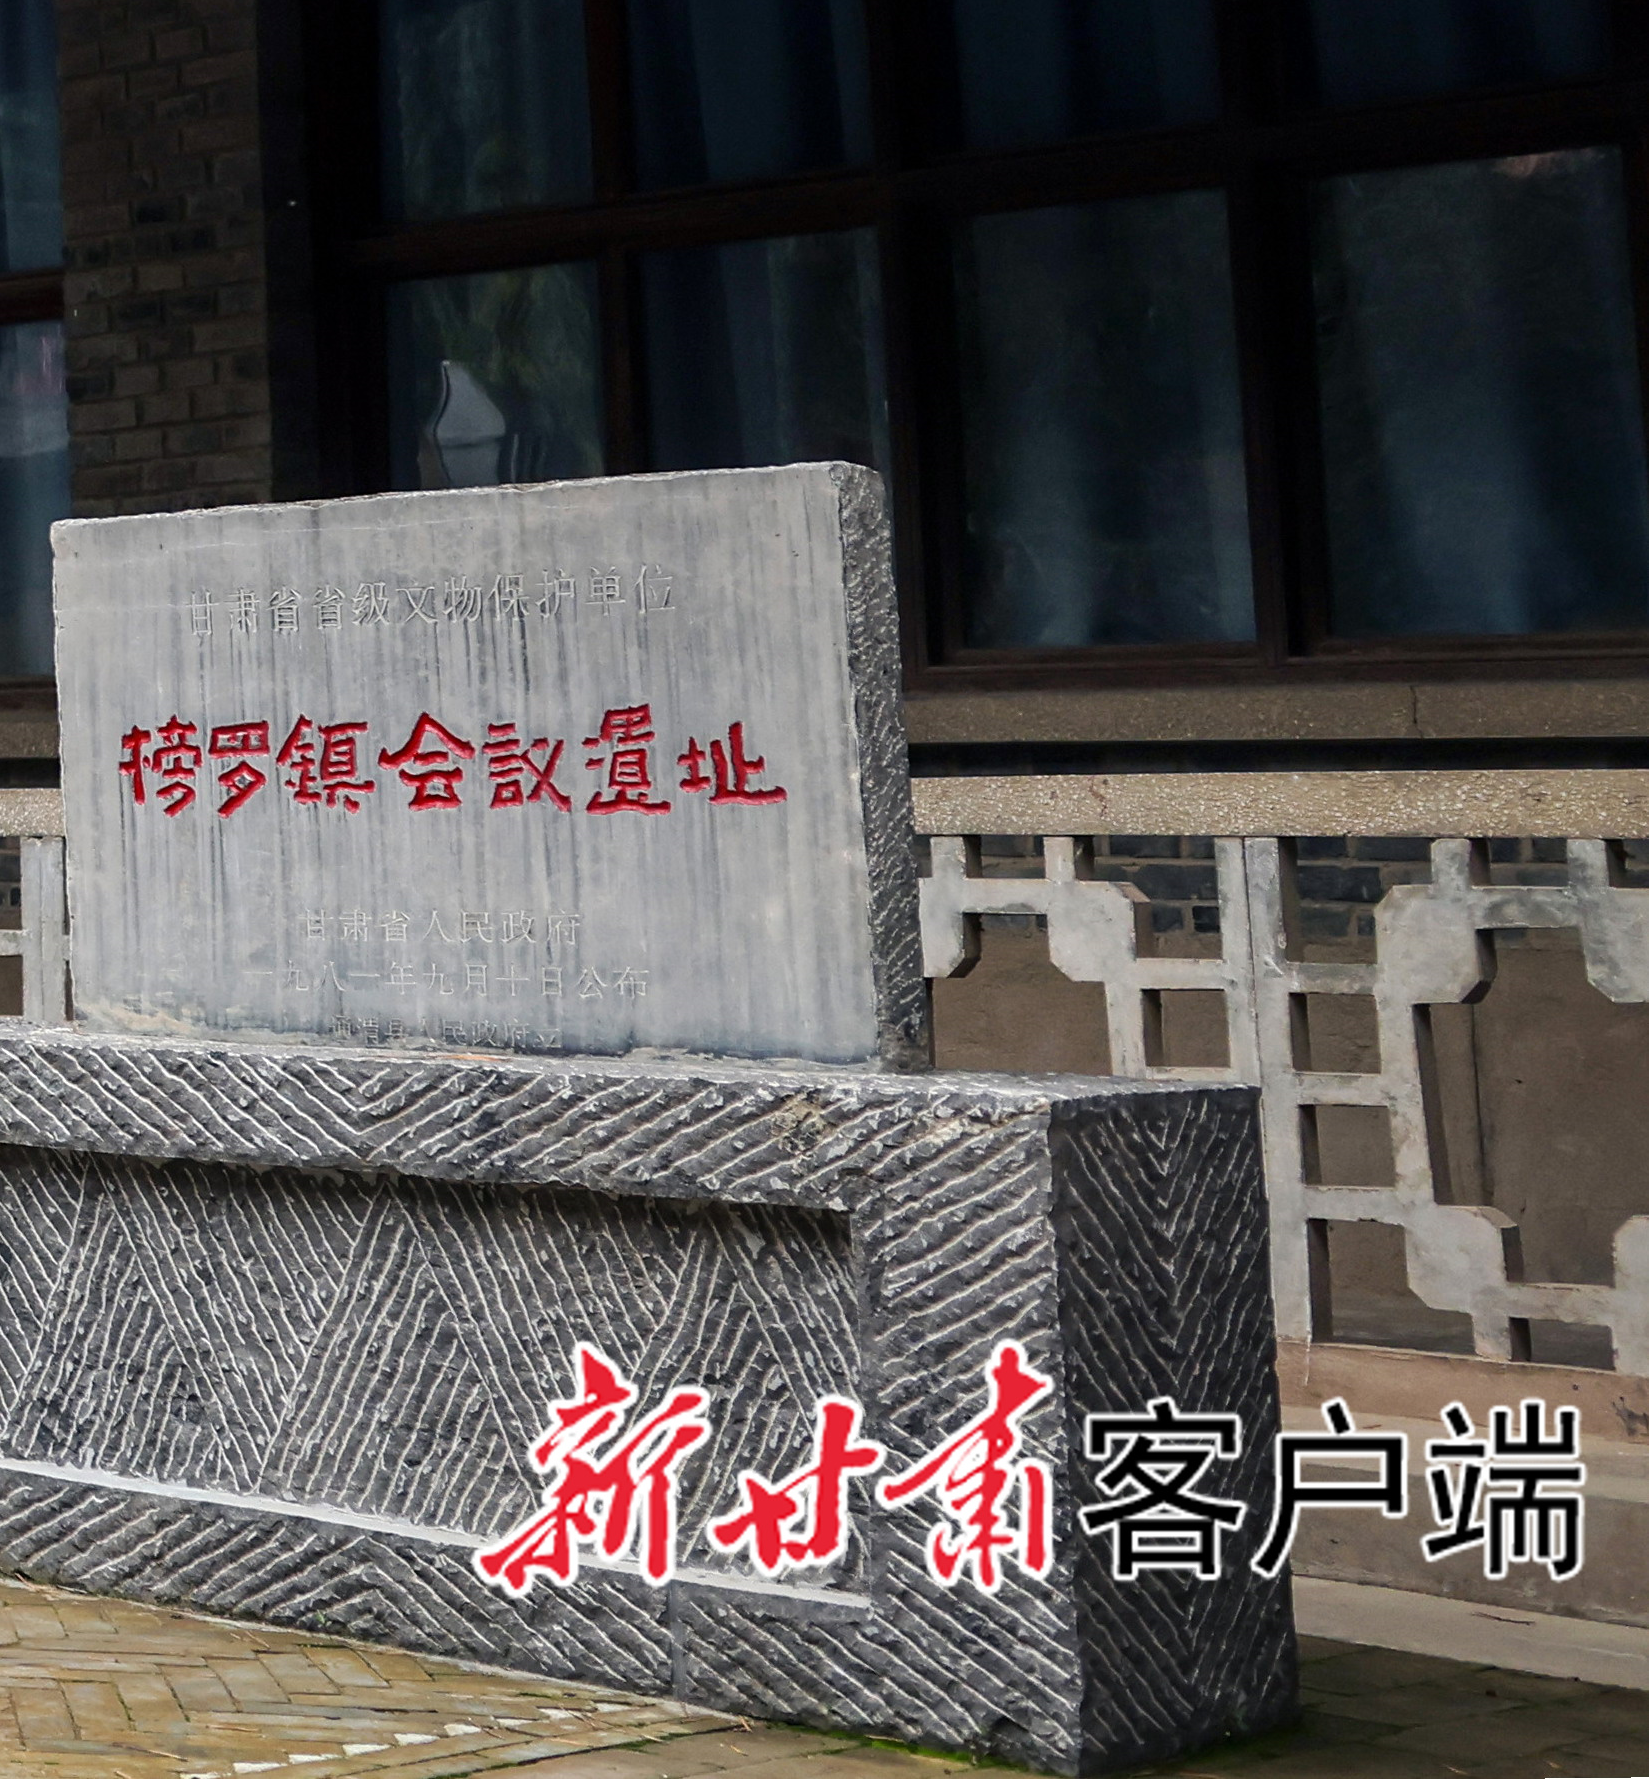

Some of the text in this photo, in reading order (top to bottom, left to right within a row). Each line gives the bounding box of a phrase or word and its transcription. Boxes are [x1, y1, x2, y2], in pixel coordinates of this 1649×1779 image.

[186, 563, 676, 637] 甘肃省省级文物保护单位
[302, 908, 582, 947] 甘肃省人民政府
[243, 959, 650, 1000] 一九八一年九月十日公布
